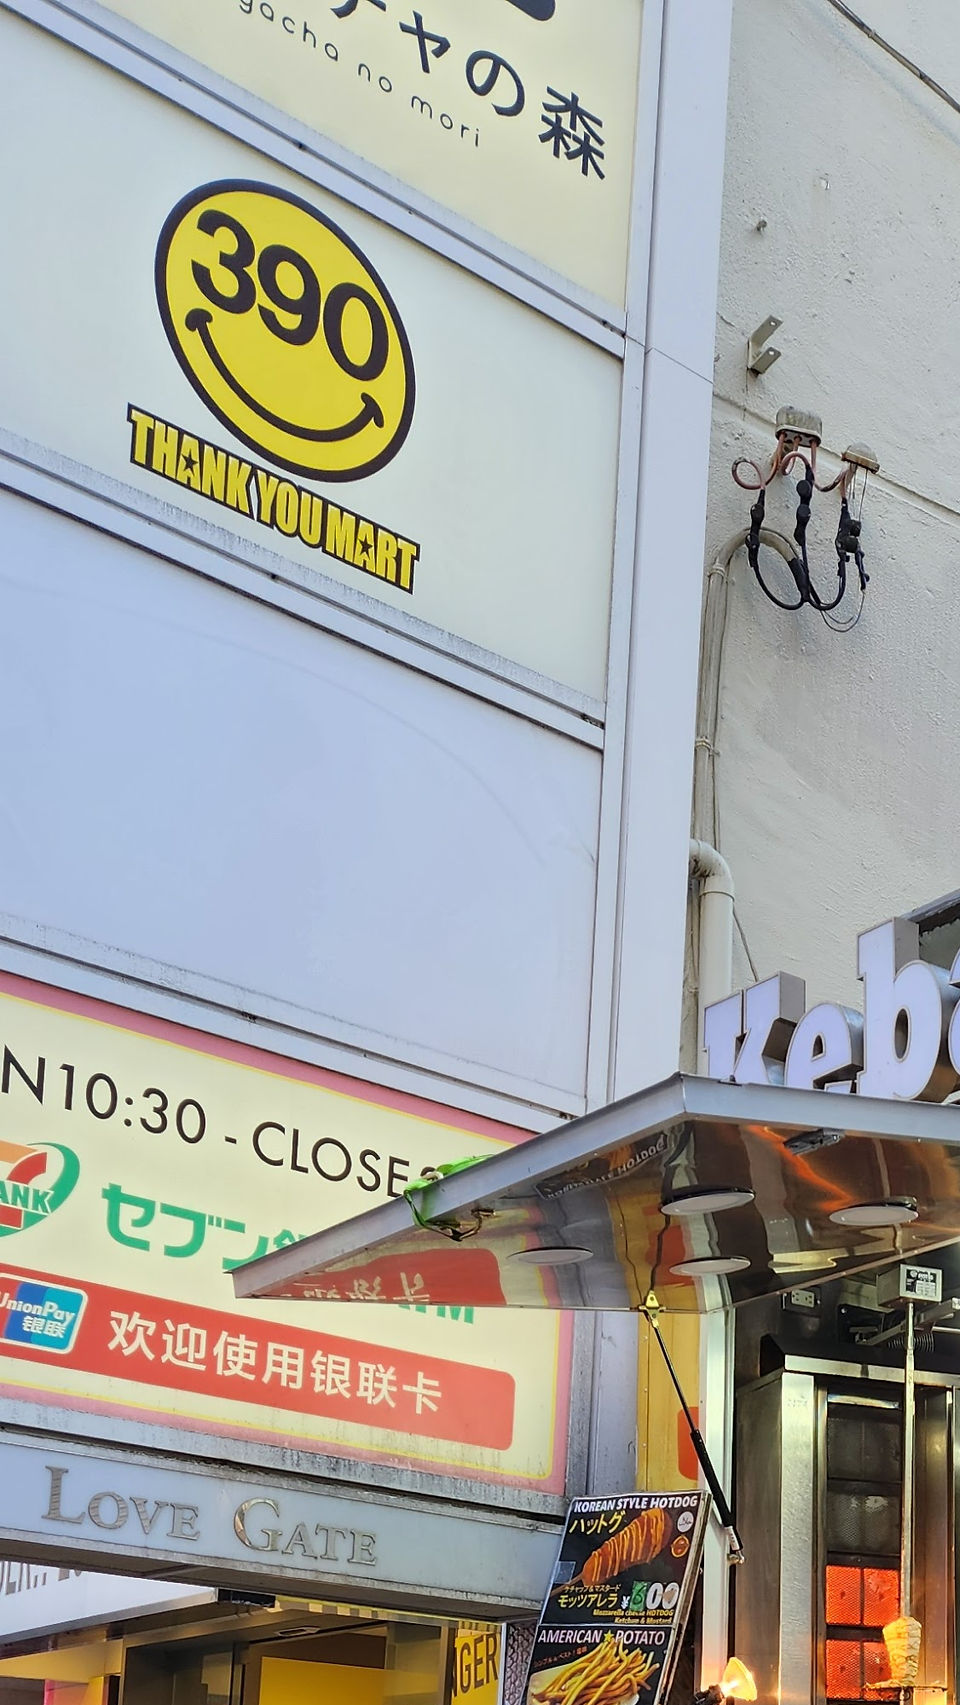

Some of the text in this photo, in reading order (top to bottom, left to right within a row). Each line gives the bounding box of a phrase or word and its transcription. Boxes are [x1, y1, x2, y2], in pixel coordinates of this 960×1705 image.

[330, 0, 605, 180] ャの森
[358, 63, 393, 93] no
[410, 95, 482, 147] mori
[191, 209, 389, 382] 390
[128, 405, 419, 592] THANK YOU MART
[22, 1316, 66, 1338] 银联
[108, 1310, 443, 1414] 欢迎使用银联卡
[568, 1511, 627, 1535] ハットグ
[574, 1496, 697, 1512] KOREAN STYLE HOTDOG
[538, 1630, 665, 1645] AMERICAN POTATO
